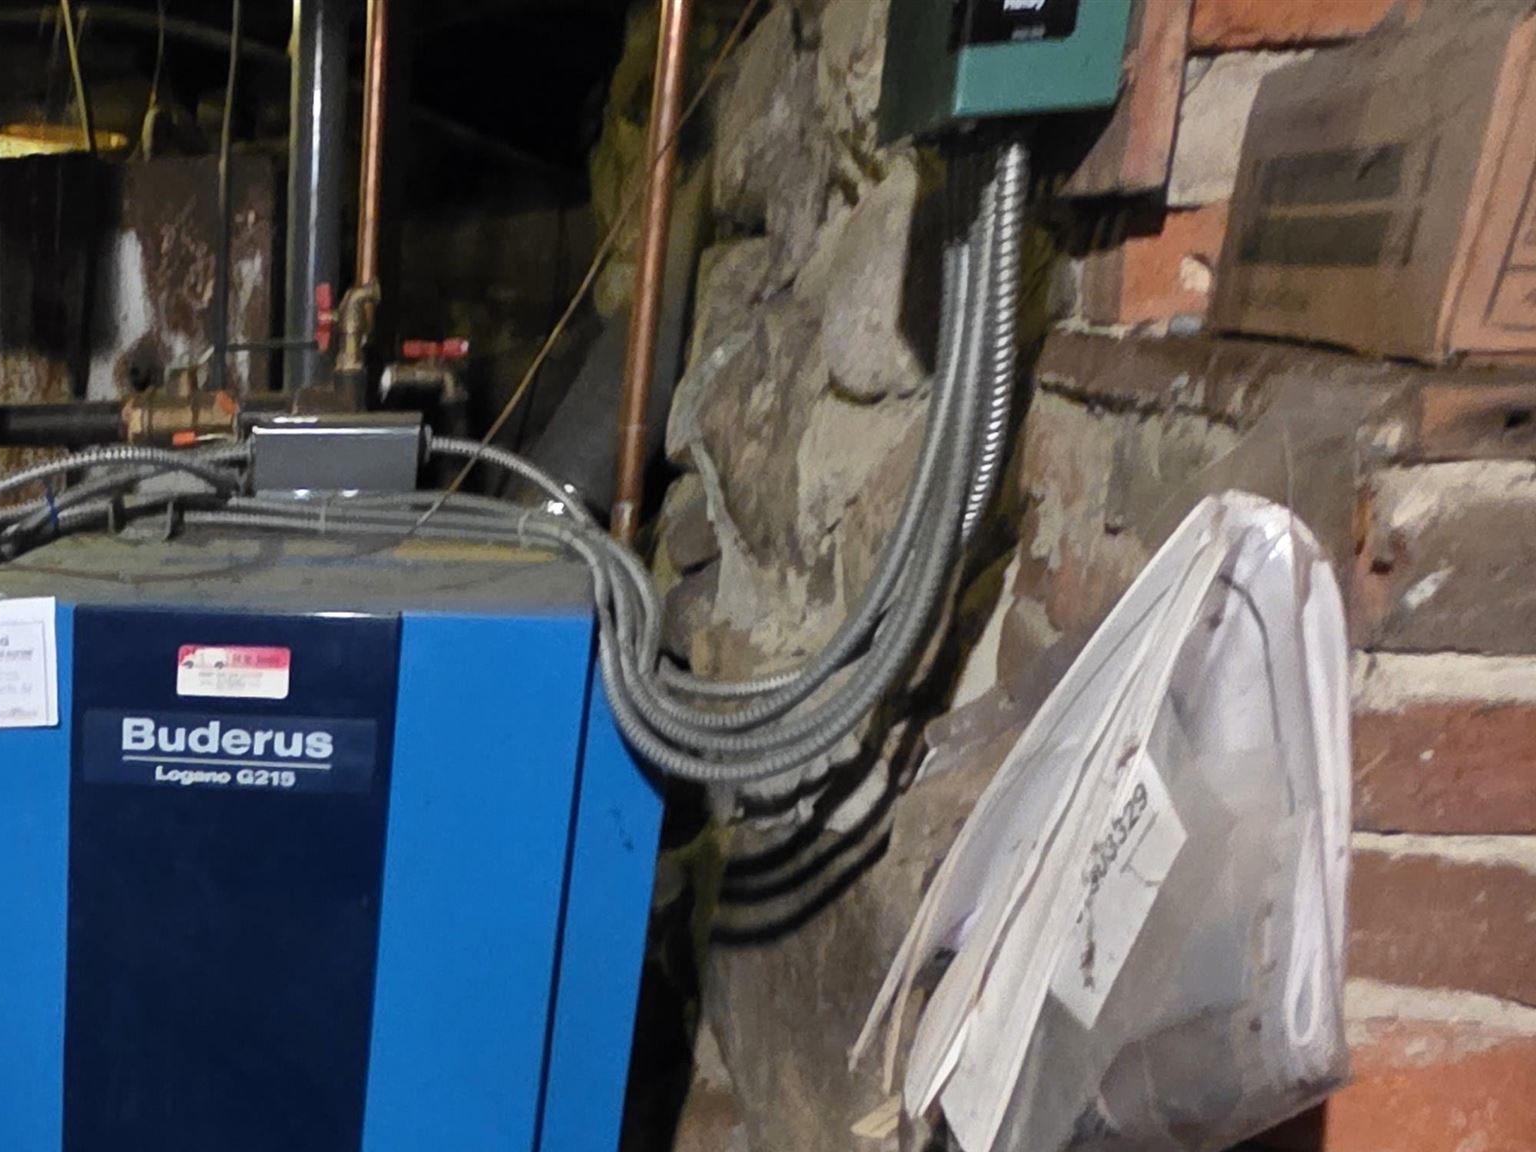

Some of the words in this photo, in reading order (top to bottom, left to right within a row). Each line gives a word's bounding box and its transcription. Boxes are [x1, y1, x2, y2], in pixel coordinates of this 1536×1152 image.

[121, 716, 334, 759] Buderus
[154, 765, 232, 786] Logano
[235, 768, 297, 788] G215
